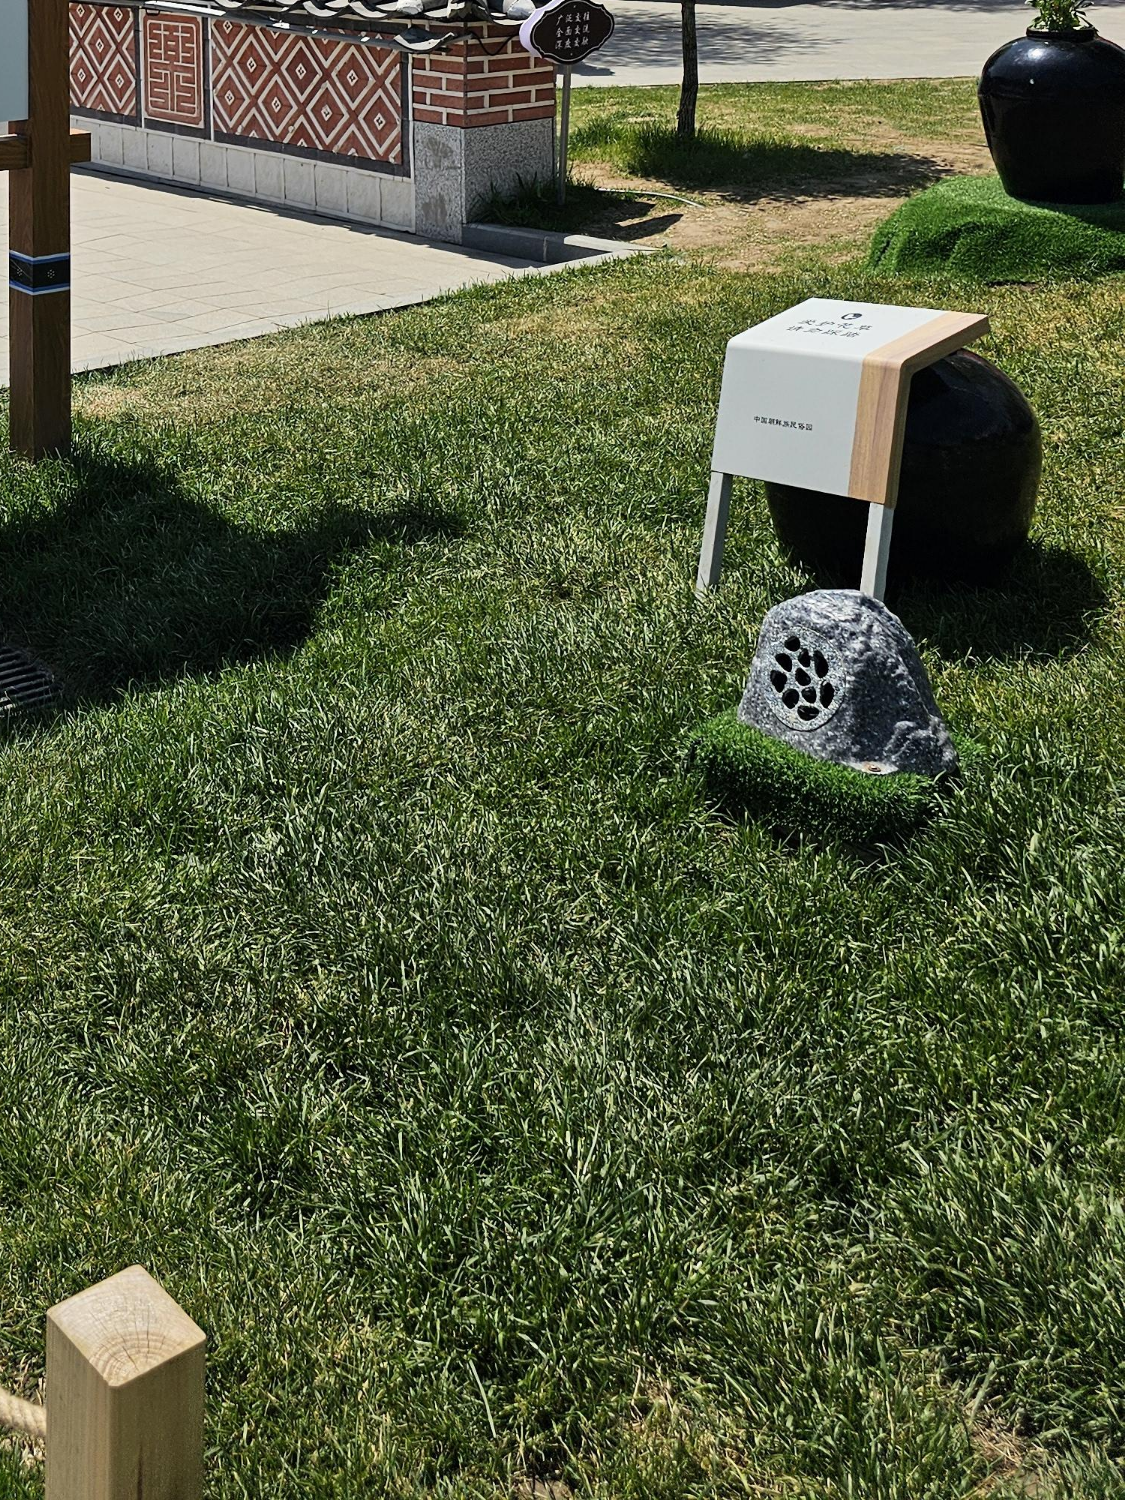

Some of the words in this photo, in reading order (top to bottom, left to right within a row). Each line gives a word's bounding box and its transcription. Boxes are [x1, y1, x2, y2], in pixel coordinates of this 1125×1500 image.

[753, 415, 813, 431] 中国朝鲜族民俗园
